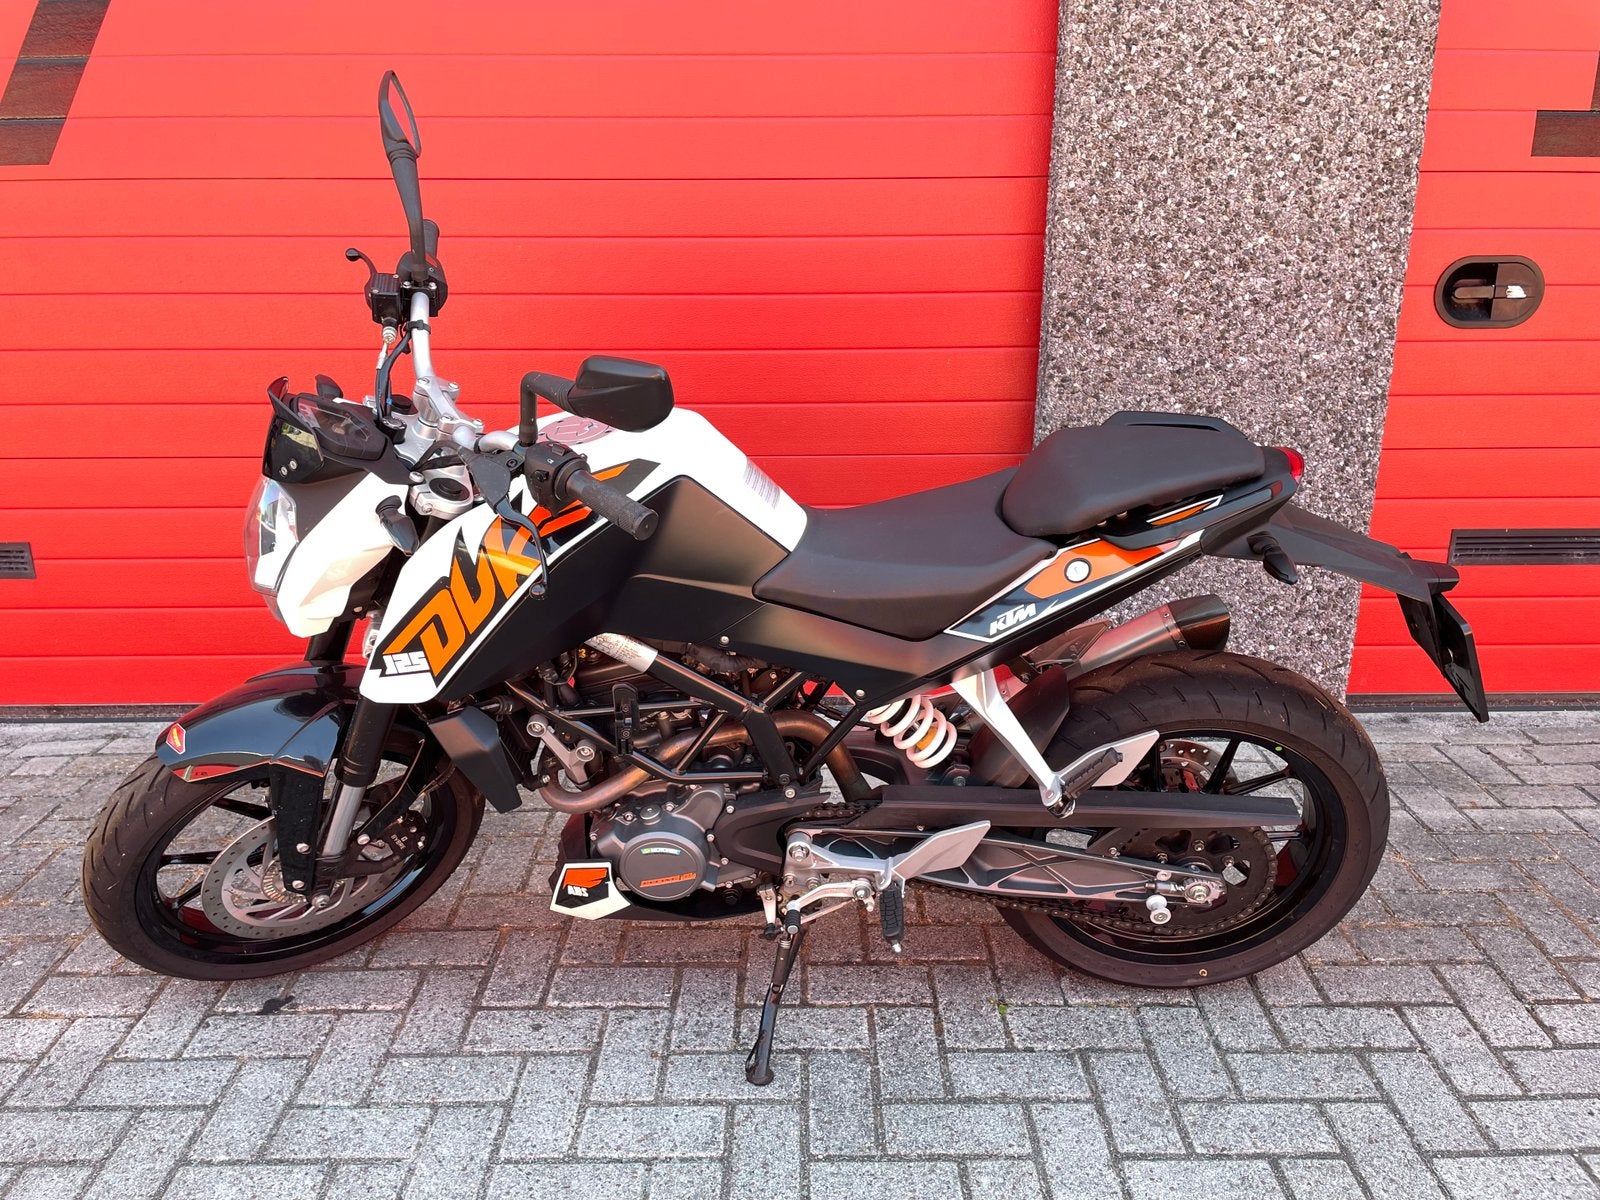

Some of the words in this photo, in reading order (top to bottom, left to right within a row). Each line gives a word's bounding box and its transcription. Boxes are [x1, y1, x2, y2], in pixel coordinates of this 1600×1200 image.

[990, 603, 1036, 636] KTM
[382, 651, 430, 675] 125
[567, 884, 589, 898] ABS
